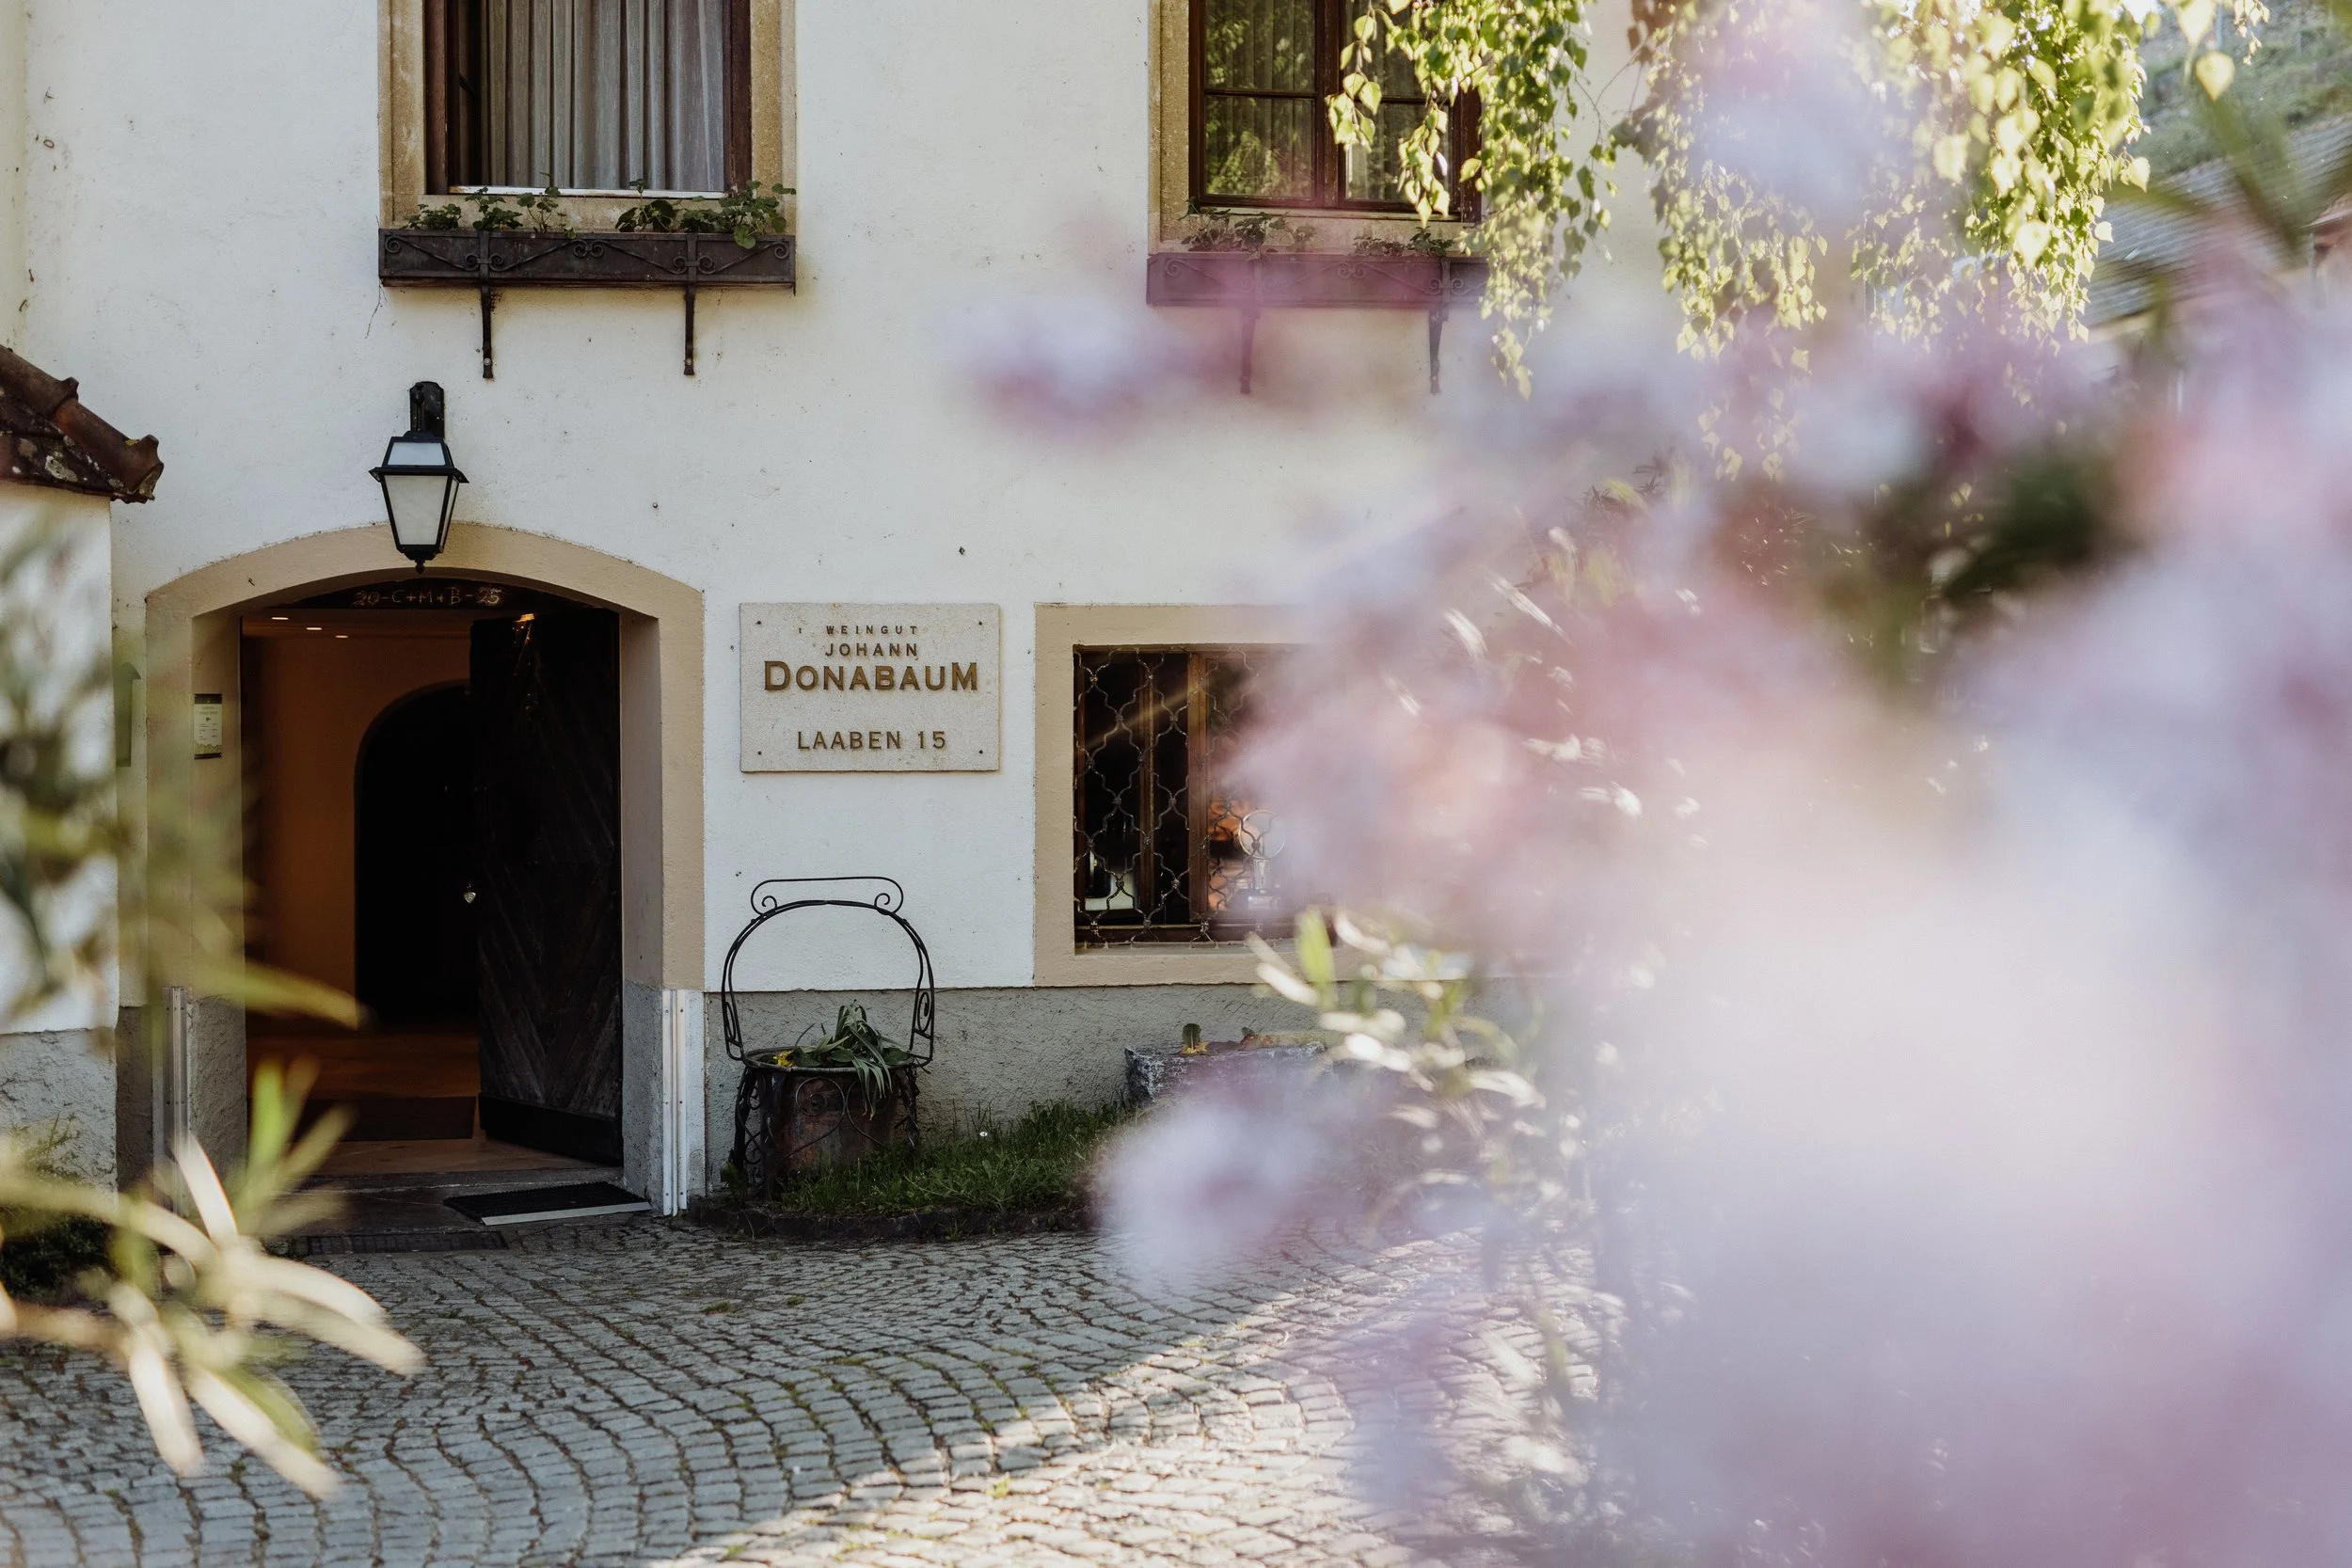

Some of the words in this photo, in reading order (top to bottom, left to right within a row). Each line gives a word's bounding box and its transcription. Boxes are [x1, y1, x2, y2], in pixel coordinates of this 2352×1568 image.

[825, 625, 919, 635] WEINGUT
[824, 642, 919, 657] JOHANN
[763, 660, 978, 691] DONABAUM
[797, 730, 901, 750] LAABEN
[917, 730, 946, 750] 15
